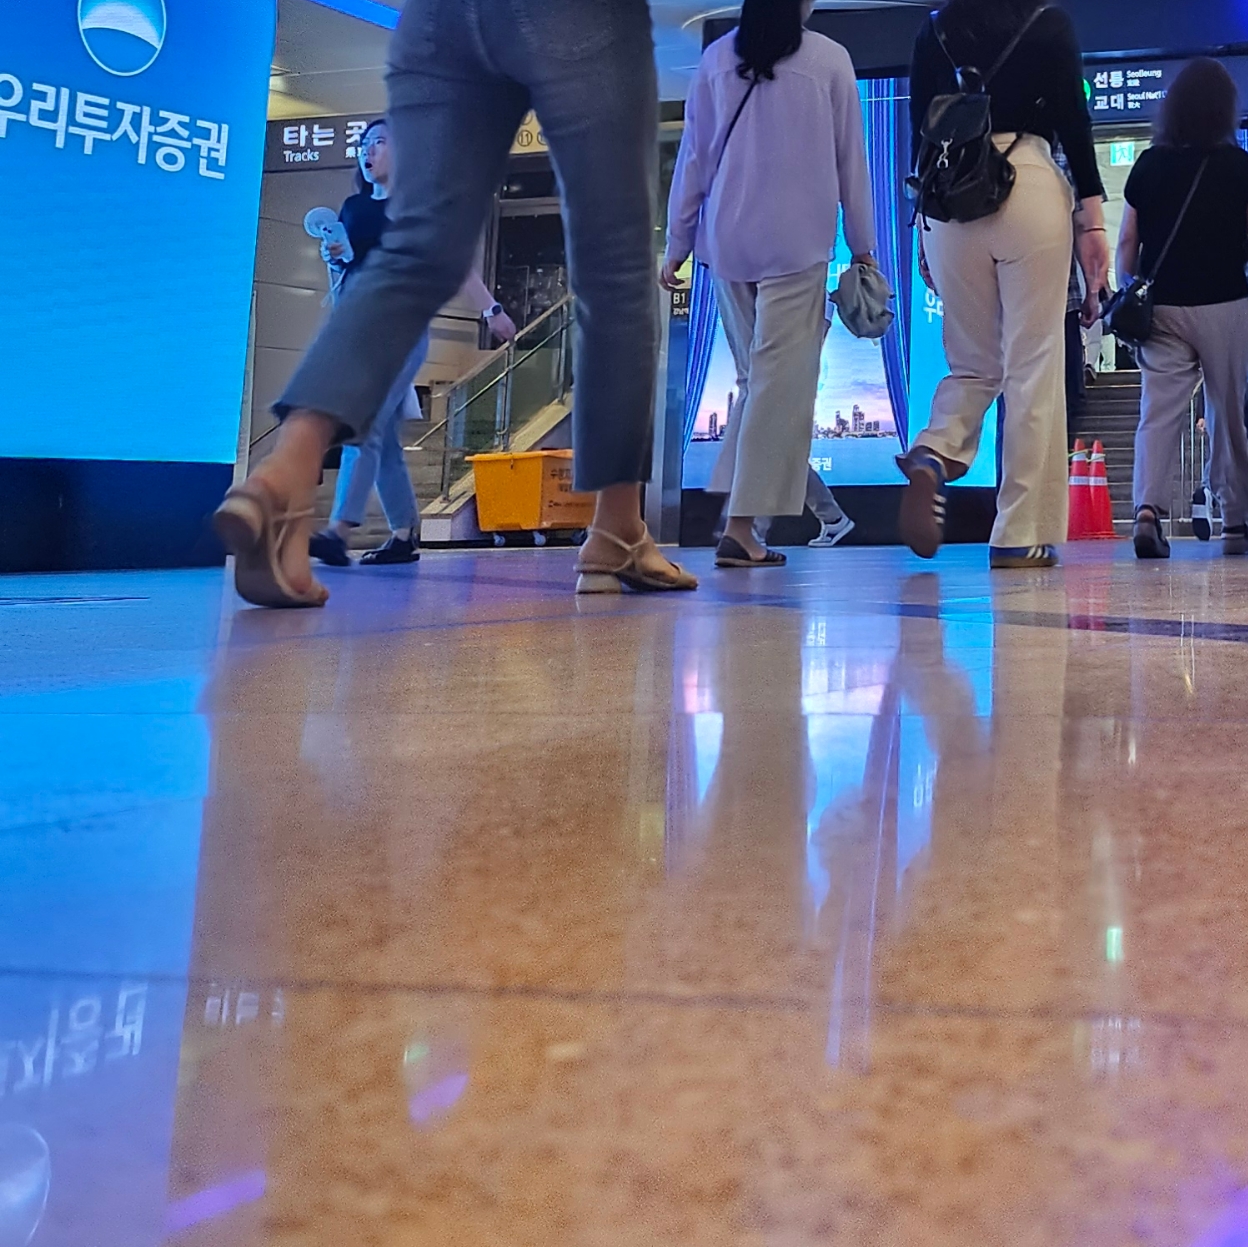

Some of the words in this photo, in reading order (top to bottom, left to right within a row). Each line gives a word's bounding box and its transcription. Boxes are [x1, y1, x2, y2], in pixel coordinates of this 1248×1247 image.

[1093, 70, 1124, 88] 선릉
[1126, 69, 1162, 78] Seolleung
[1093, 93, 1124, 110] 교대
[1127, 92, 1145, 101] Seoul
[0, 73, 229, 180] 우리투자증권
[283, 124, 335, 147] 타는
[345, 121, 367, 143] 곳
[283, 149, 320, 162] Tracks
[673, 293, 685, 304] B1
[808, 457, 832, 471] 증권
